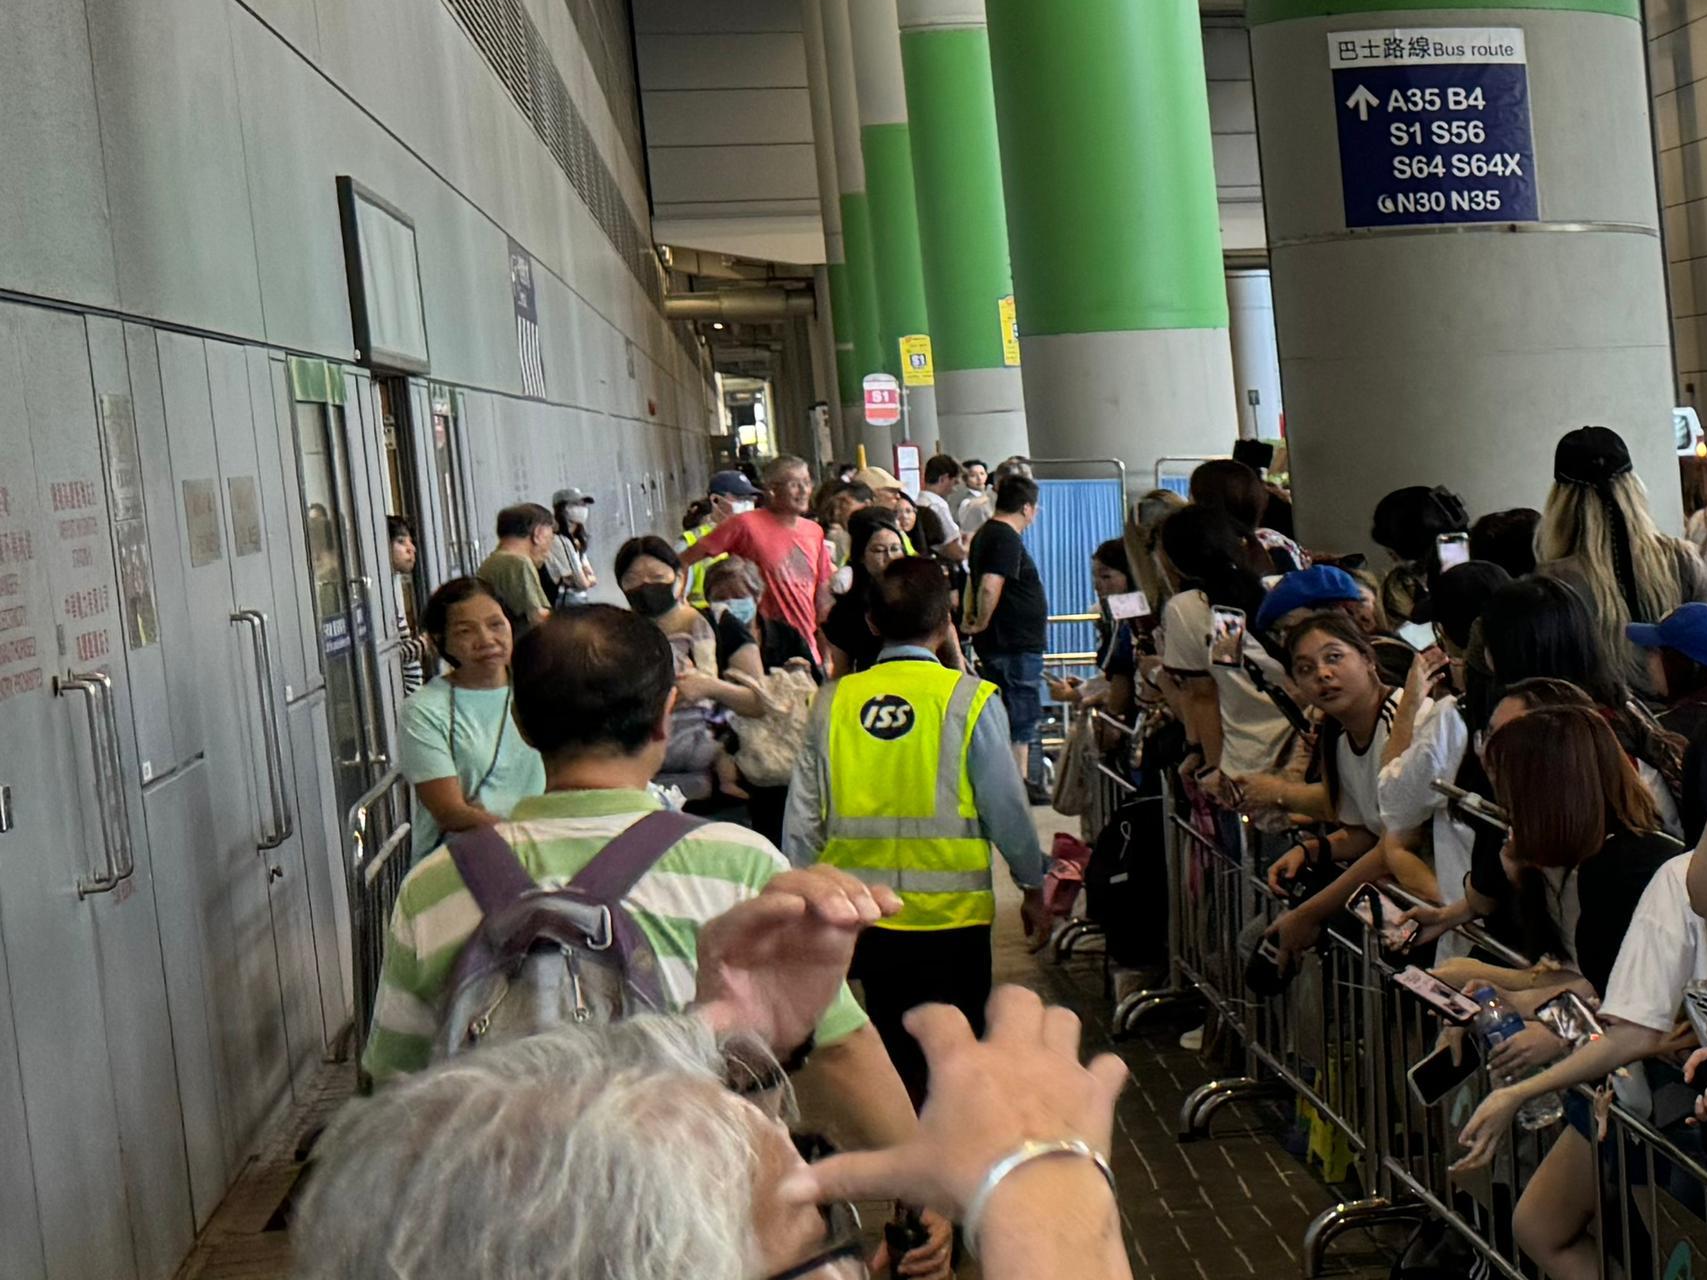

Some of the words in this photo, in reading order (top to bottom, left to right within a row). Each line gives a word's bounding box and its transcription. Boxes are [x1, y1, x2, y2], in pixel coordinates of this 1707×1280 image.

[1338, 36, 1430, 61] 巴士路線
[1433, 43, 1465, 57] Bus
[1471, 42, 1515, 57] route
[1387, 88, 1441, 112] A35
[1447, 86, 1487, 111] B4
[1390, 122, 1422, 146] S1
[1431, 120, 1485, 144] S56
[1393, 155, 1446, 179] S64
[1451, 153, 1523, 177] S64X
[1397, 191, 1446, 213] N30
[1451, 189, 1501, 211] N35
